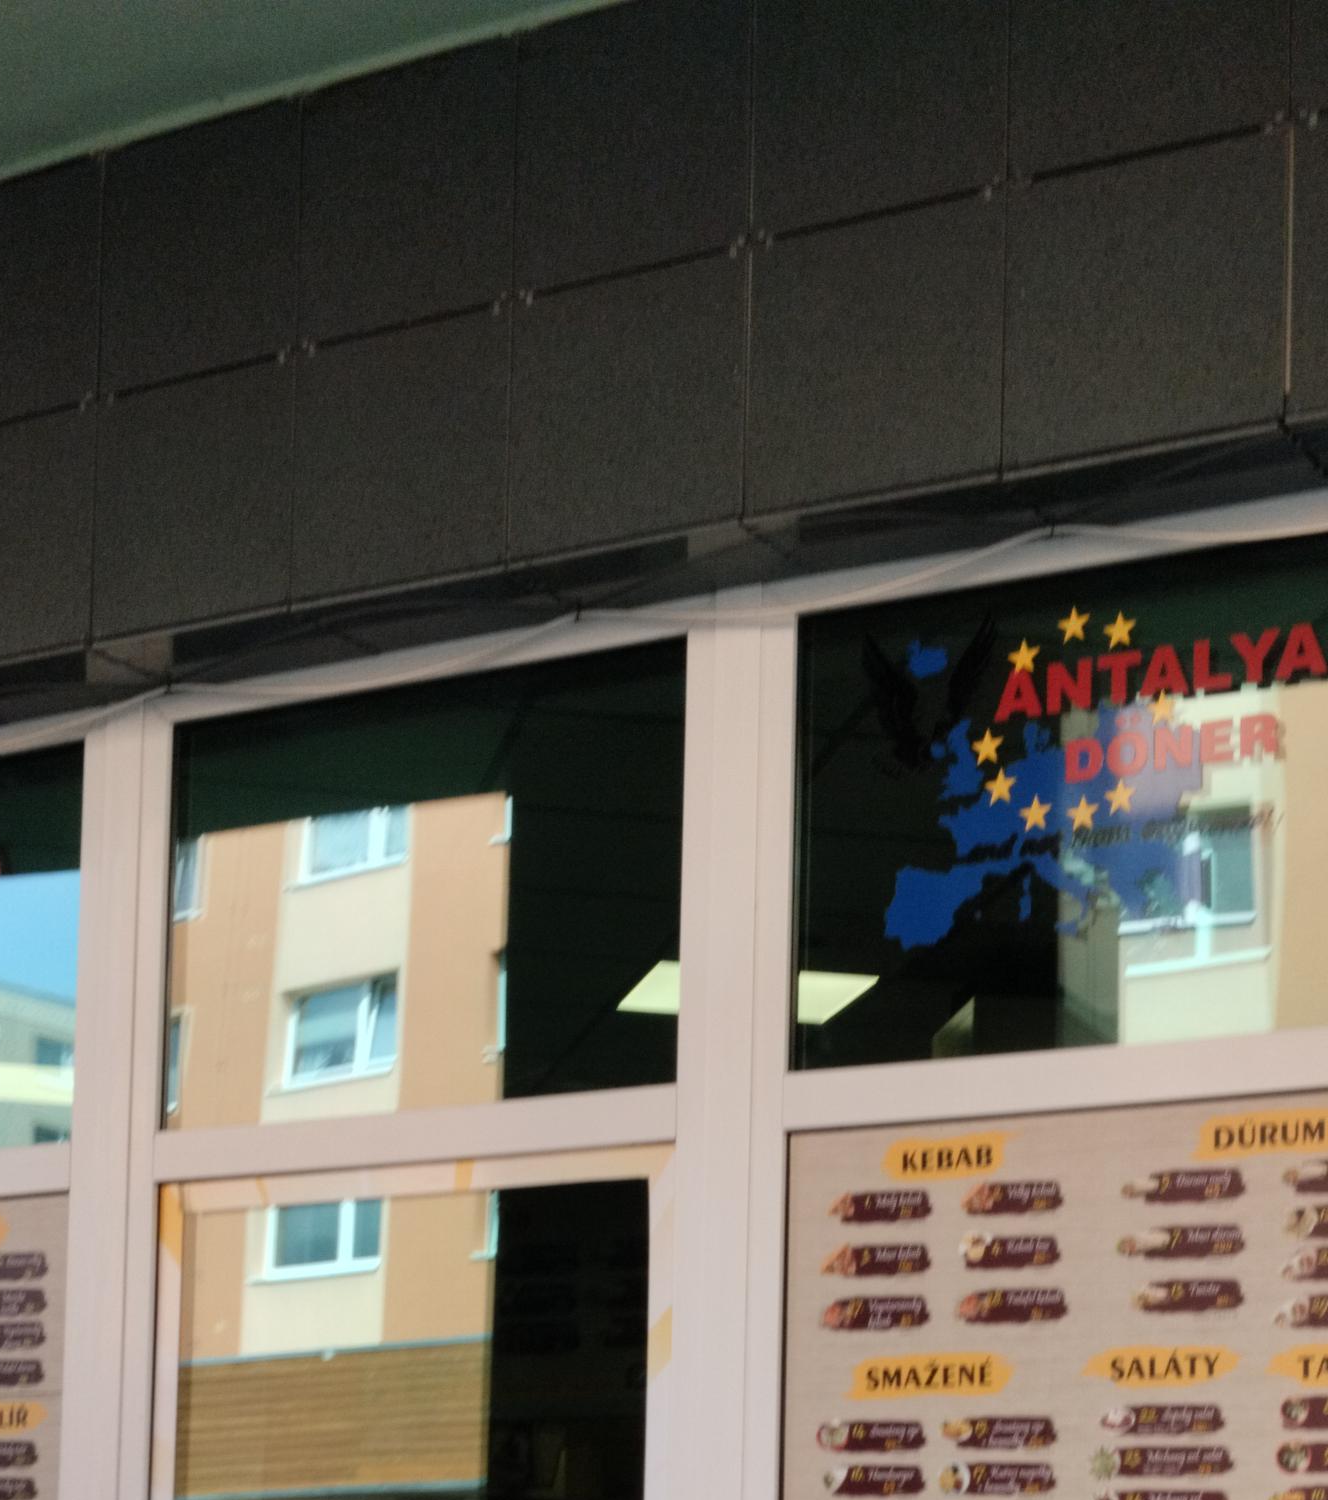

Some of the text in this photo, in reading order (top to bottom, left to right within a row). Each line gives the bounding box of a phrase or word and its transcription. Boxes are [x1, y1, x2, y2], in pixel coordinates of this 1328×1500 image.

[993, 622, 1328, 724] ANTALYA
[1064, 713, 1283, 785] DÖNER
[902, 1143, 993, 1173] KEBAB
[865, 1355, 993, 1391] SMAŽENÉ
[1110, 1348, 1221, 1382] SALÁTY
